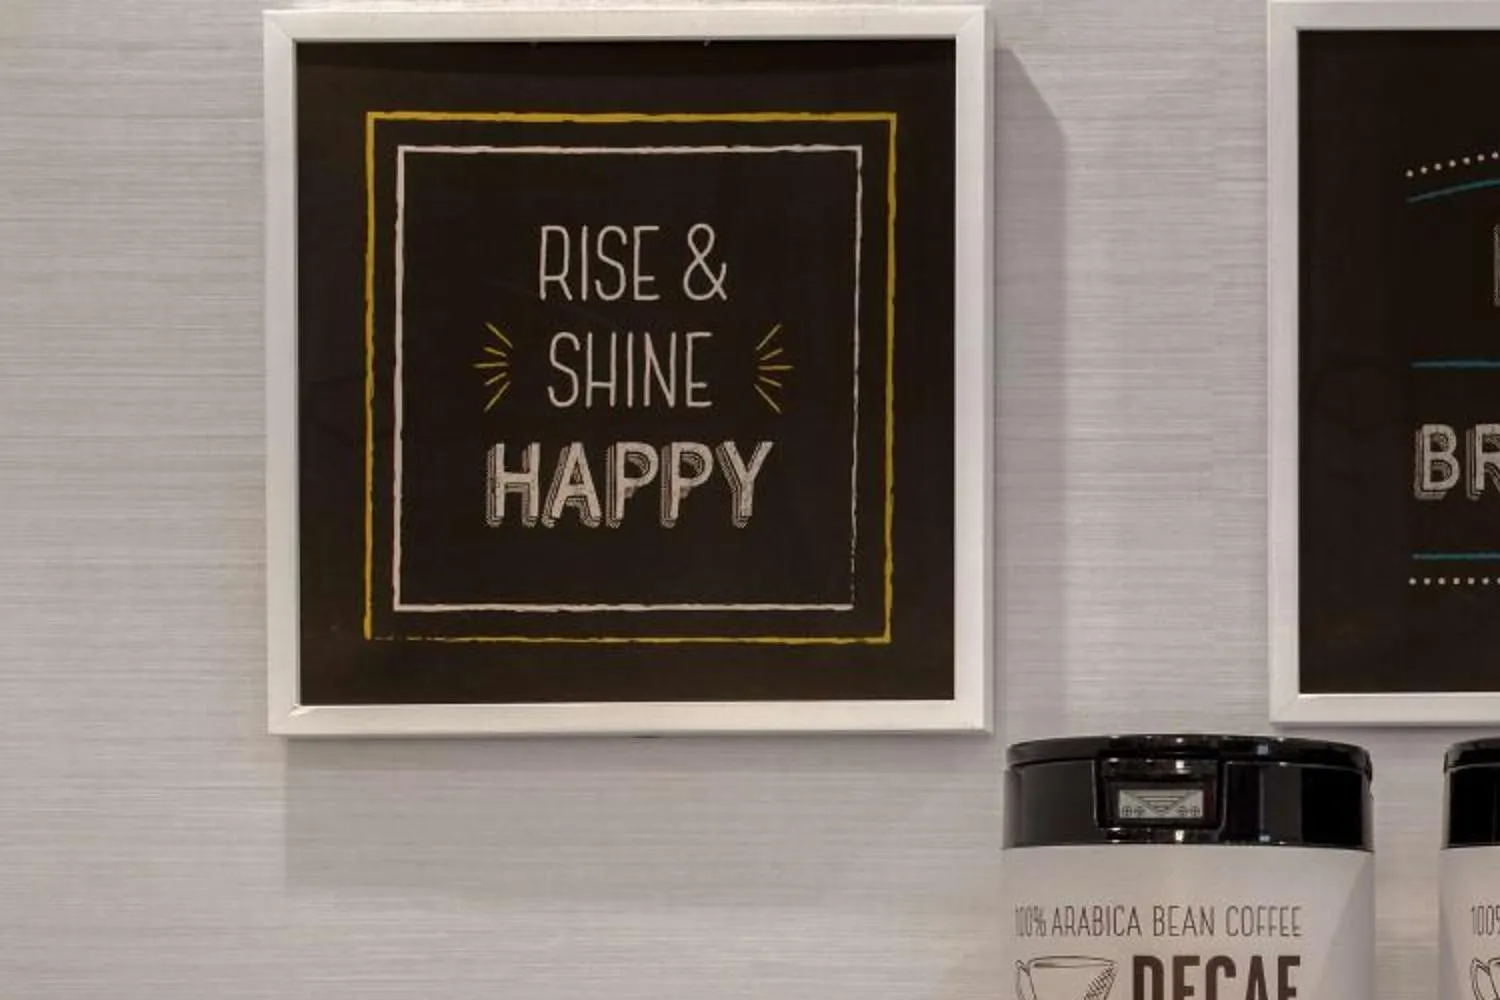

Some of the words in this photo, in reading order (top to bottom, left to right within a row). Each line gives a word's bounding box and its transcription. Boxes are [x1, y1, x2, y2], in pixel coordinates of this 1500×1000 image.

[539, 225, 660, 301] RISE
[683, 223, 728, 301] &
[548, 331, 713, 408] SHINE
[486, 441, 774, 529] HAPPY
[1014, 905, 1047, 938] 100%
[1051, 904, 1143, 937] ARABICA
[1152, 904, 1216, 937] BEAN
[1225, 905, 1304, 938] COFFEE
